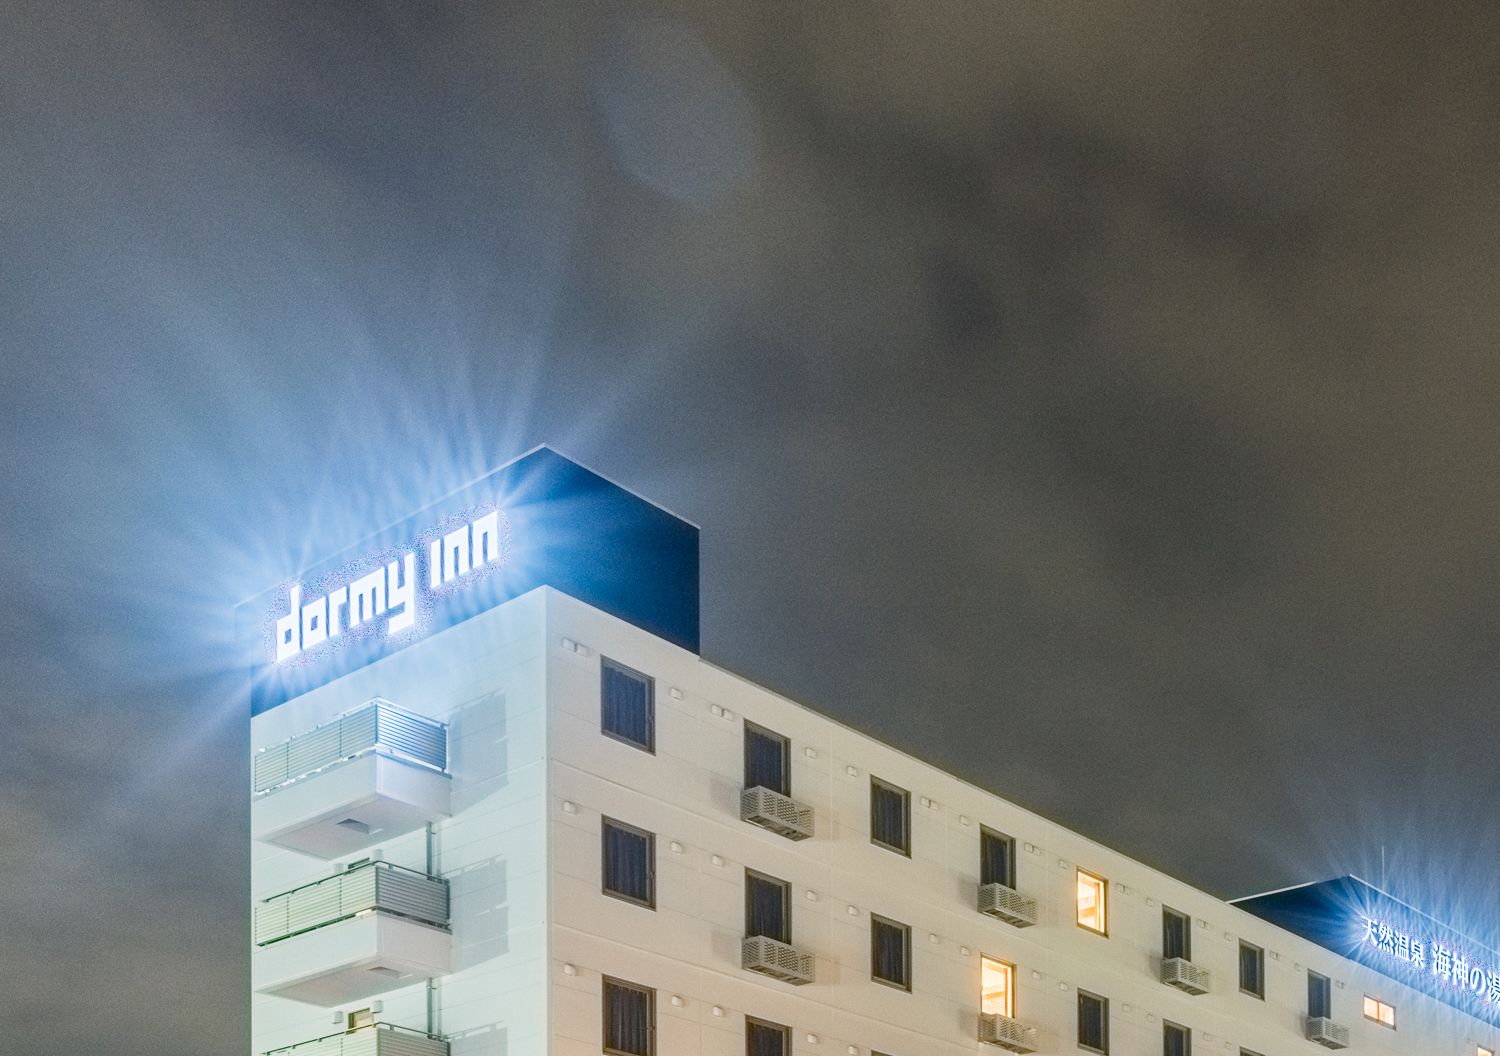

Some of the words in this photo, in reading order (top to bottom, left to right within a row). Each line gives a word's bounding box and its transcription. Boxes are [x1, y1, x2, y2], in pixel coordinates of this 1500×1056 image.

[275, 552, 416, 663] dormy
[430, 510, 498, 589] inn
[1361, 915, 1424, 968] 天然温泉
